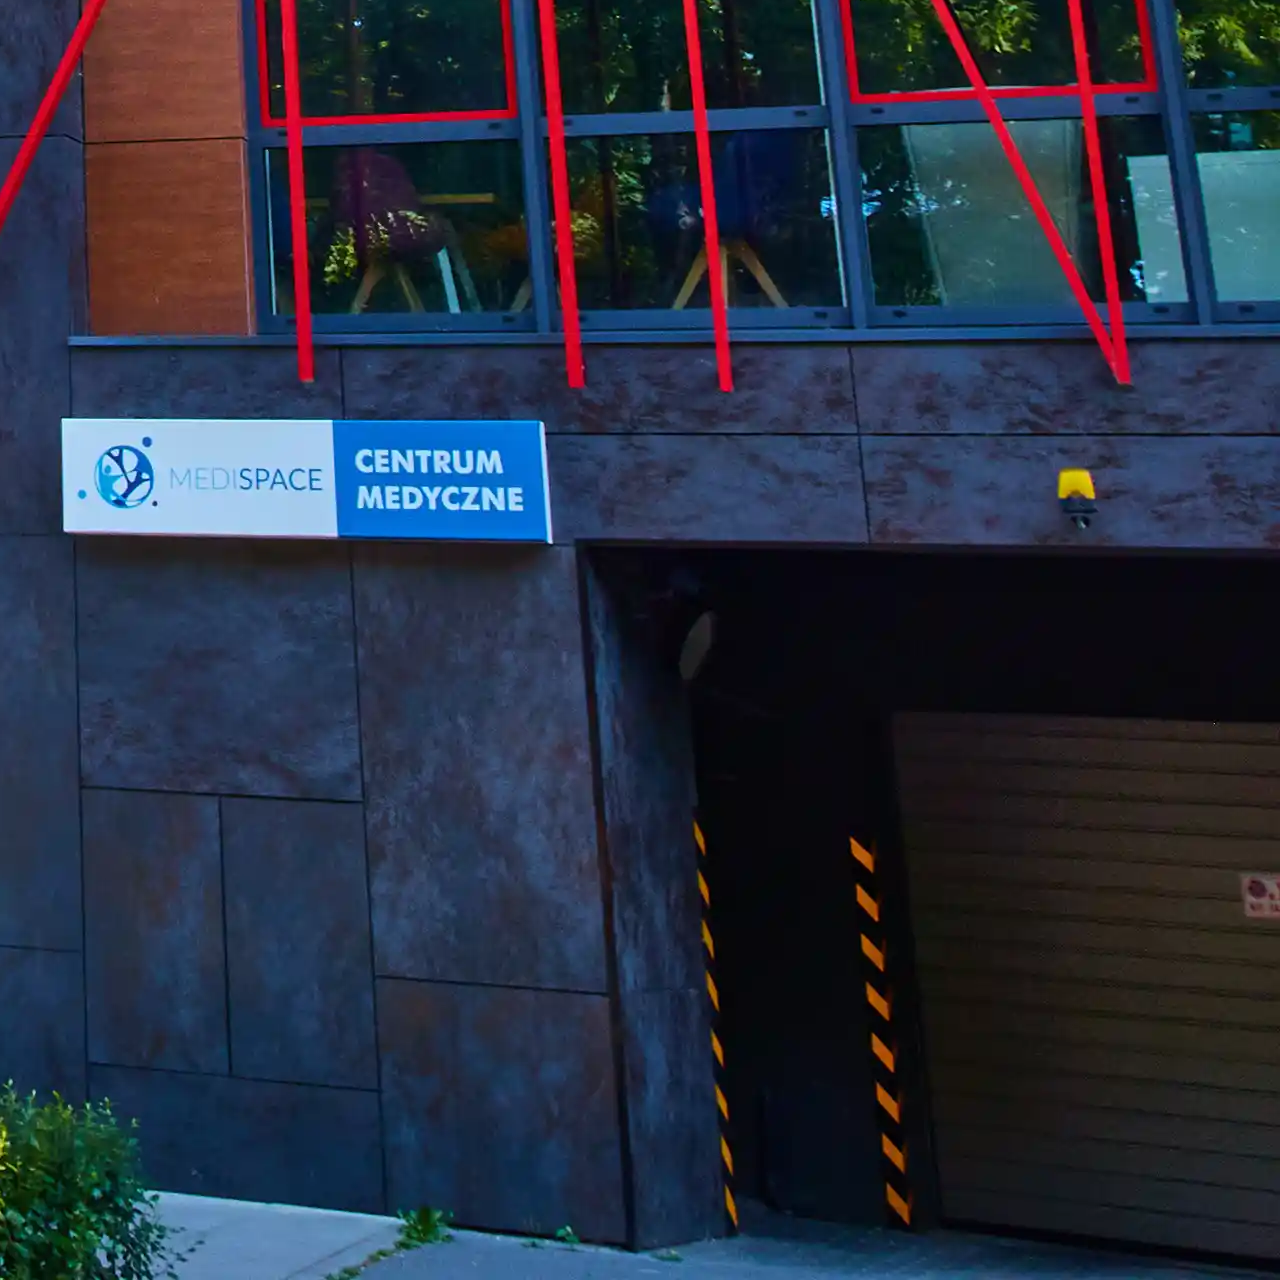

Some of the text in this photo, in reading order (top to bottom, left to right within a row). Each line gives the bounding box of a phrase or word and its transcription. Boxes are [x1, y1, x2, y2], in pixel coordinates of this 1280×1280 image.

[354, 448, 504, 475] CENTRUM
[169, 467, 323, 491] MEDISPACE
[356, 485, 524, 512] MEDYCZNE
